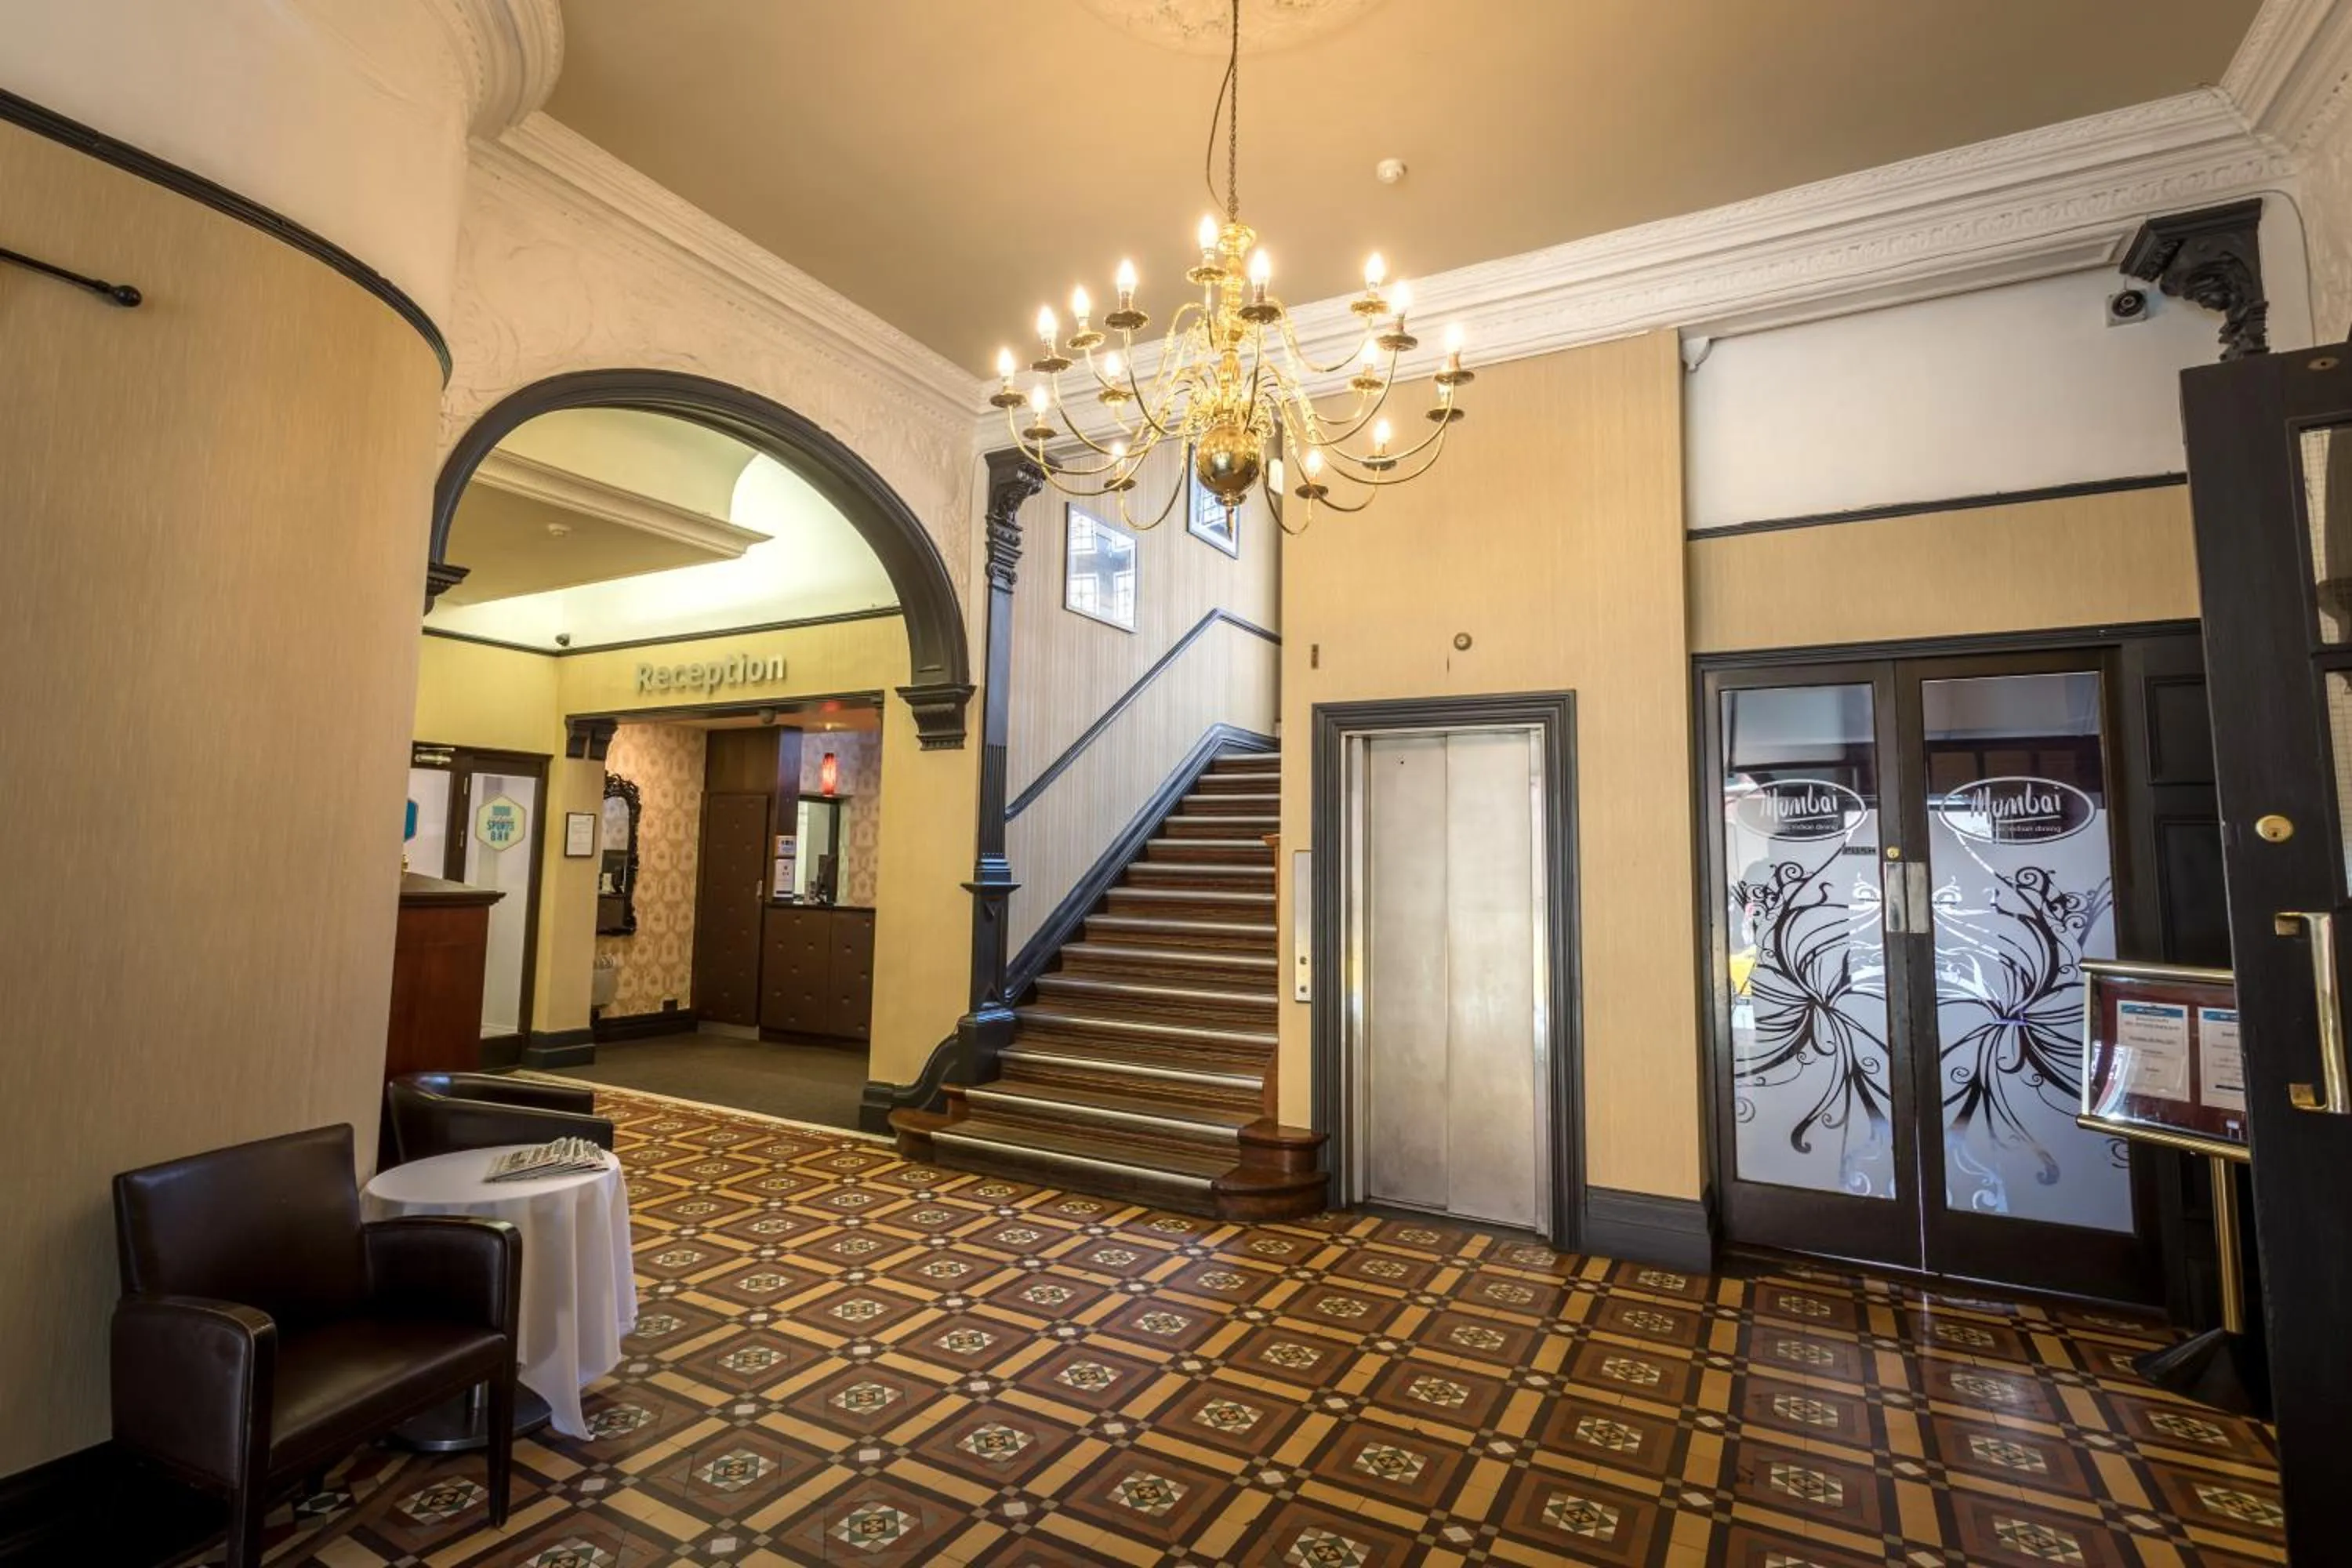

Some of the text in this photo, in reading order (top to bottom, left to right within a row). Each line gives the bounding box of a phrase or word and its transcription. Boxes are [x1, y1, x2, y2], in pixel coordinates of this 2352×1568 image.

[636, 655, 786, 695] Reception
[1759, 784, 1838, 822] Mumbai
[1970, 782, 2061, 824] Mumbai
